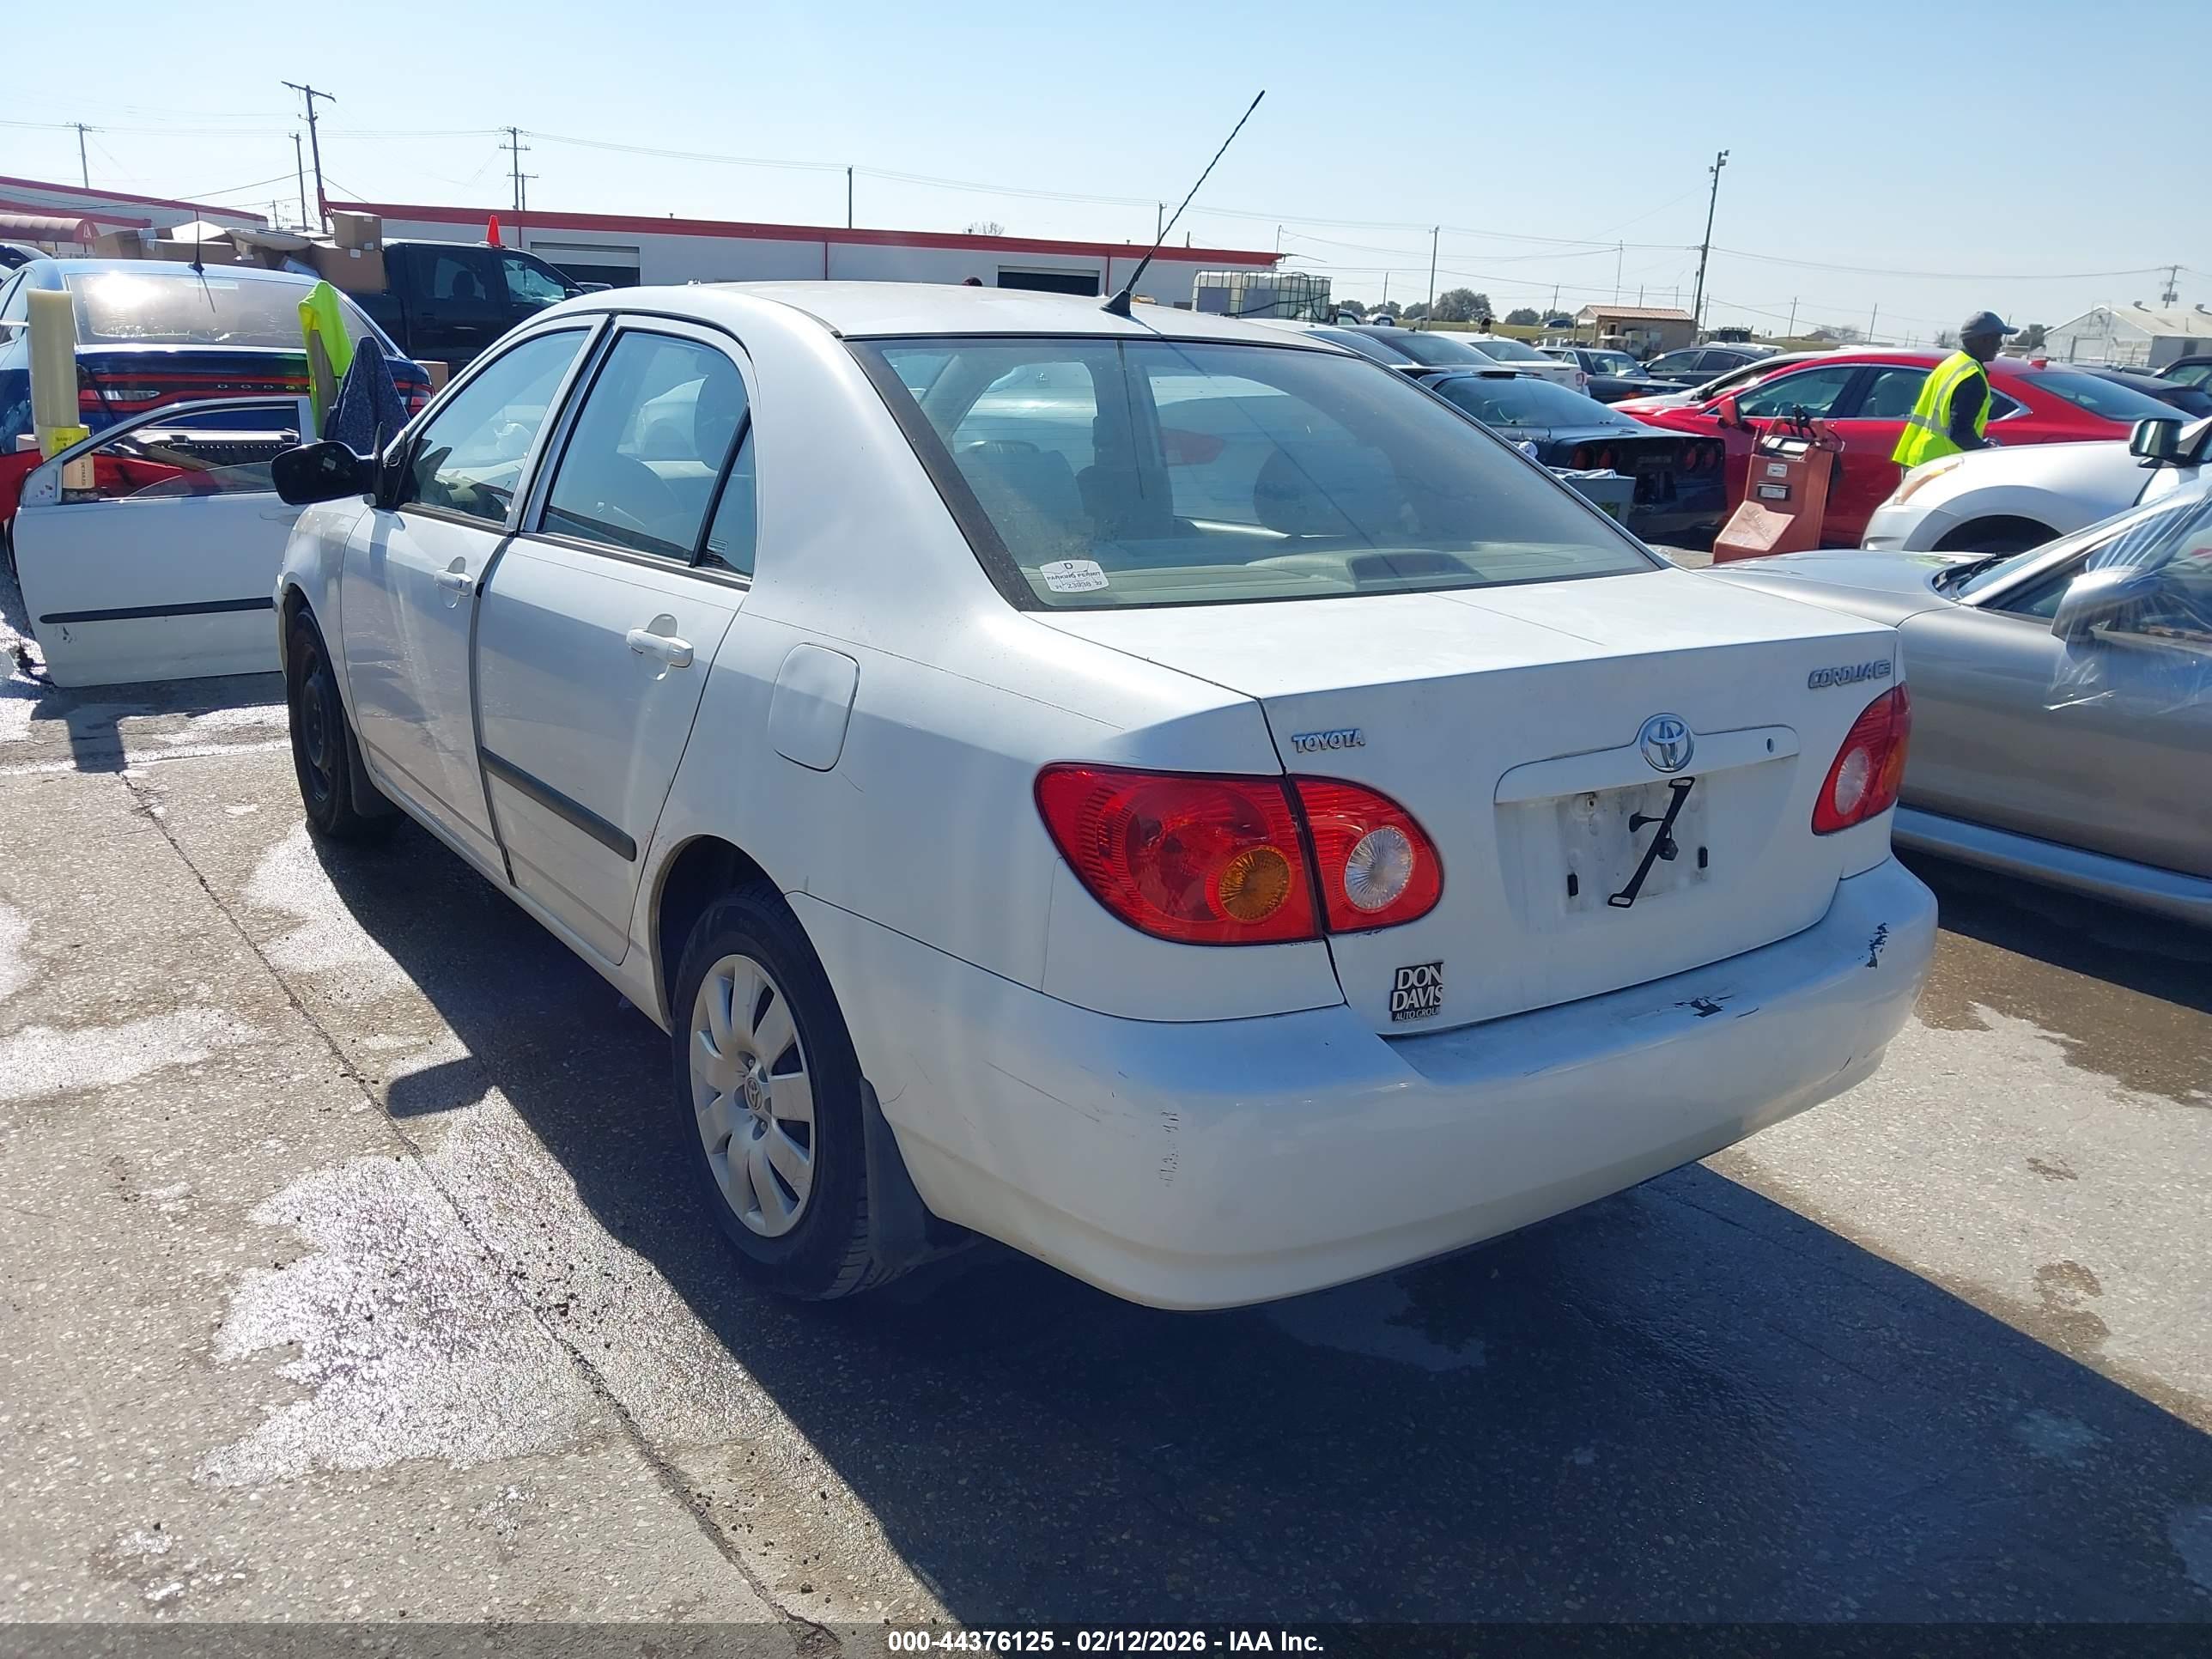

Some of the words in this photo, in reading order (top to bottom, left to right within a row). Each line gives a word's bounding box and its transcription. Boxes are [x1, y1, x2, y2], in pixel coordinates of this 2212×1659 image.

[1808, 663, 1873, 690] COROLLA
[1291, 729, 1366, 753] TOYOTA
[1397, 963, 1443, 990] DON
[1392, 984, 1443, 1012] DAVIS
[1395, 1010, 1416, 1021] AUTO
